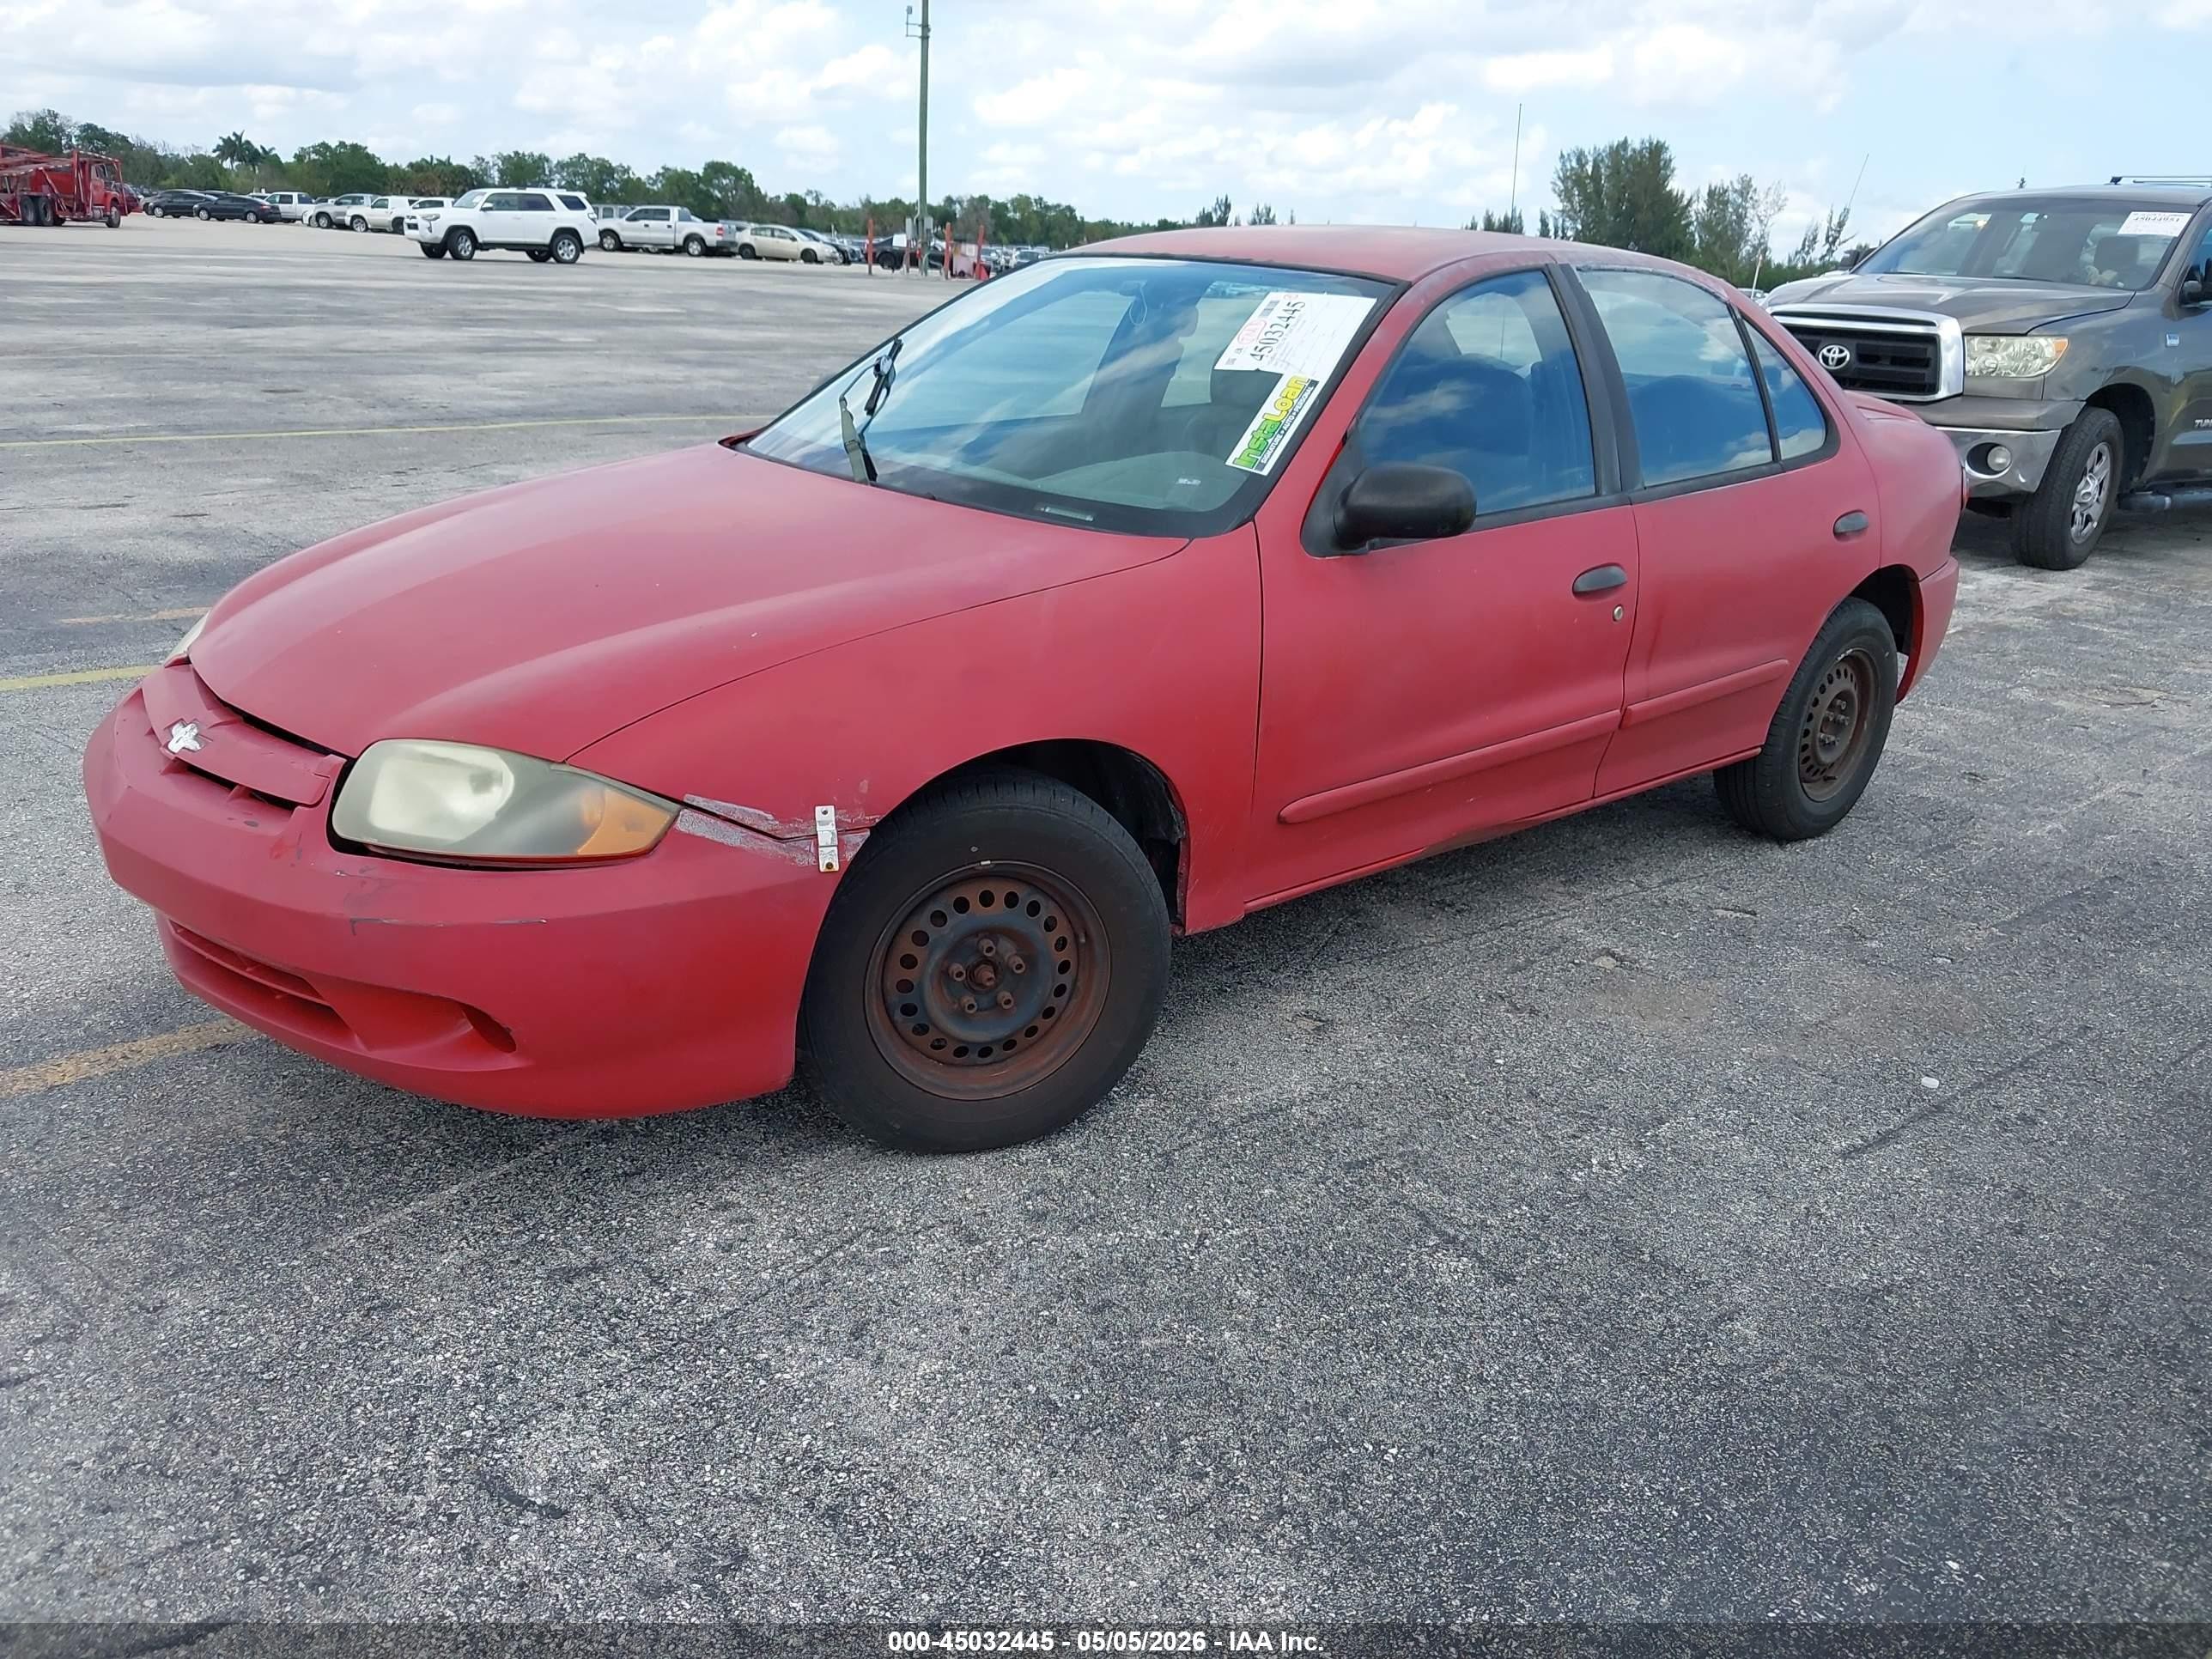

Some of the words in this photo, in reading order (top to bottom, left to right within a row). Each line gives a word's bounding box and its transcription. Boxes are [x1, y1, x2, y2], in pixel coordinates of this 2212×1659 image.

[1250, 301, 1305, 362] 45032445
[1233, 375, 1310, 468] InstaLoan
[1261, 433, 1283, 463] SIGNATURE
[1283, 415, 1295, 431] AUTO
